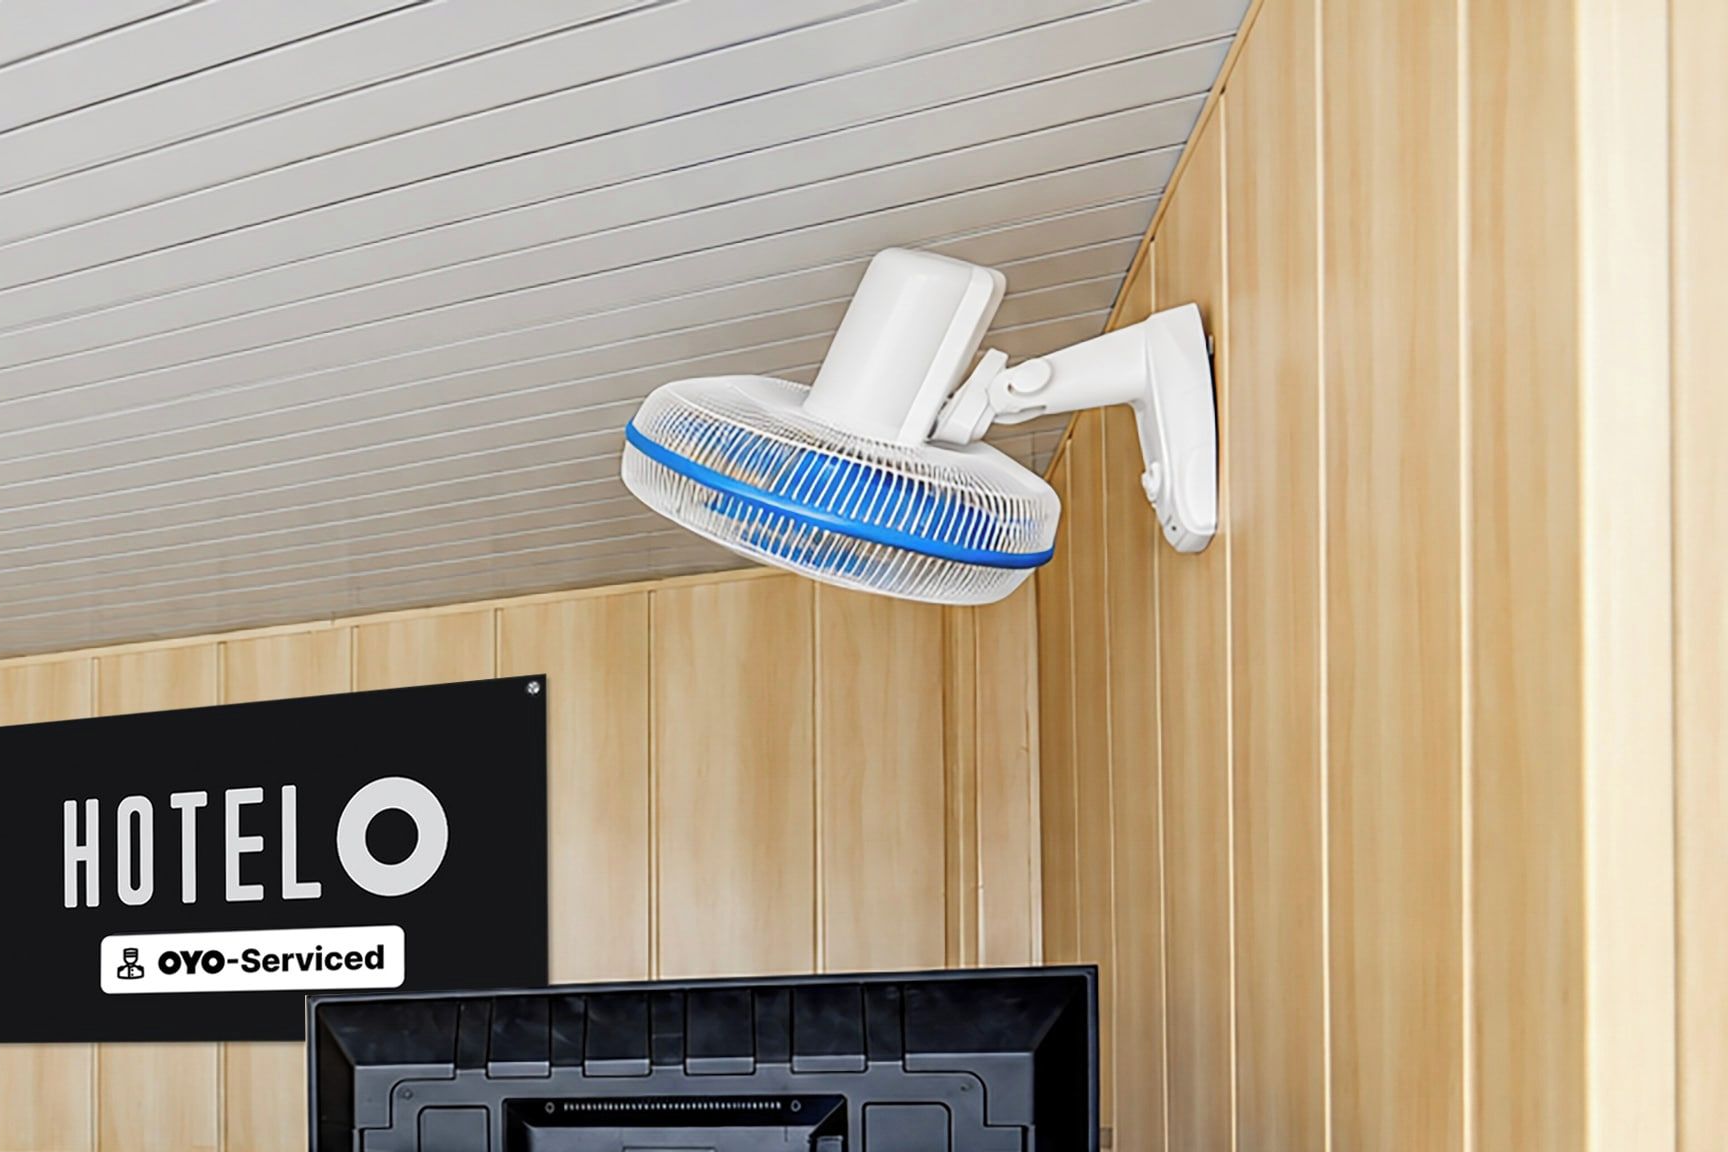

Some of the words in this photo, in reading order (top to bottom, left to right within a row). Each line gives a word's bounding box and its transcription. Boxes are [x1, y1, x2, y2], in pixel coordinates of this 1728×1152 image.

[63, 784, 322, 909] HOTEL
[336, 776, 449, 897] O
[158, 944, 384, 975] OYO-Serviced
